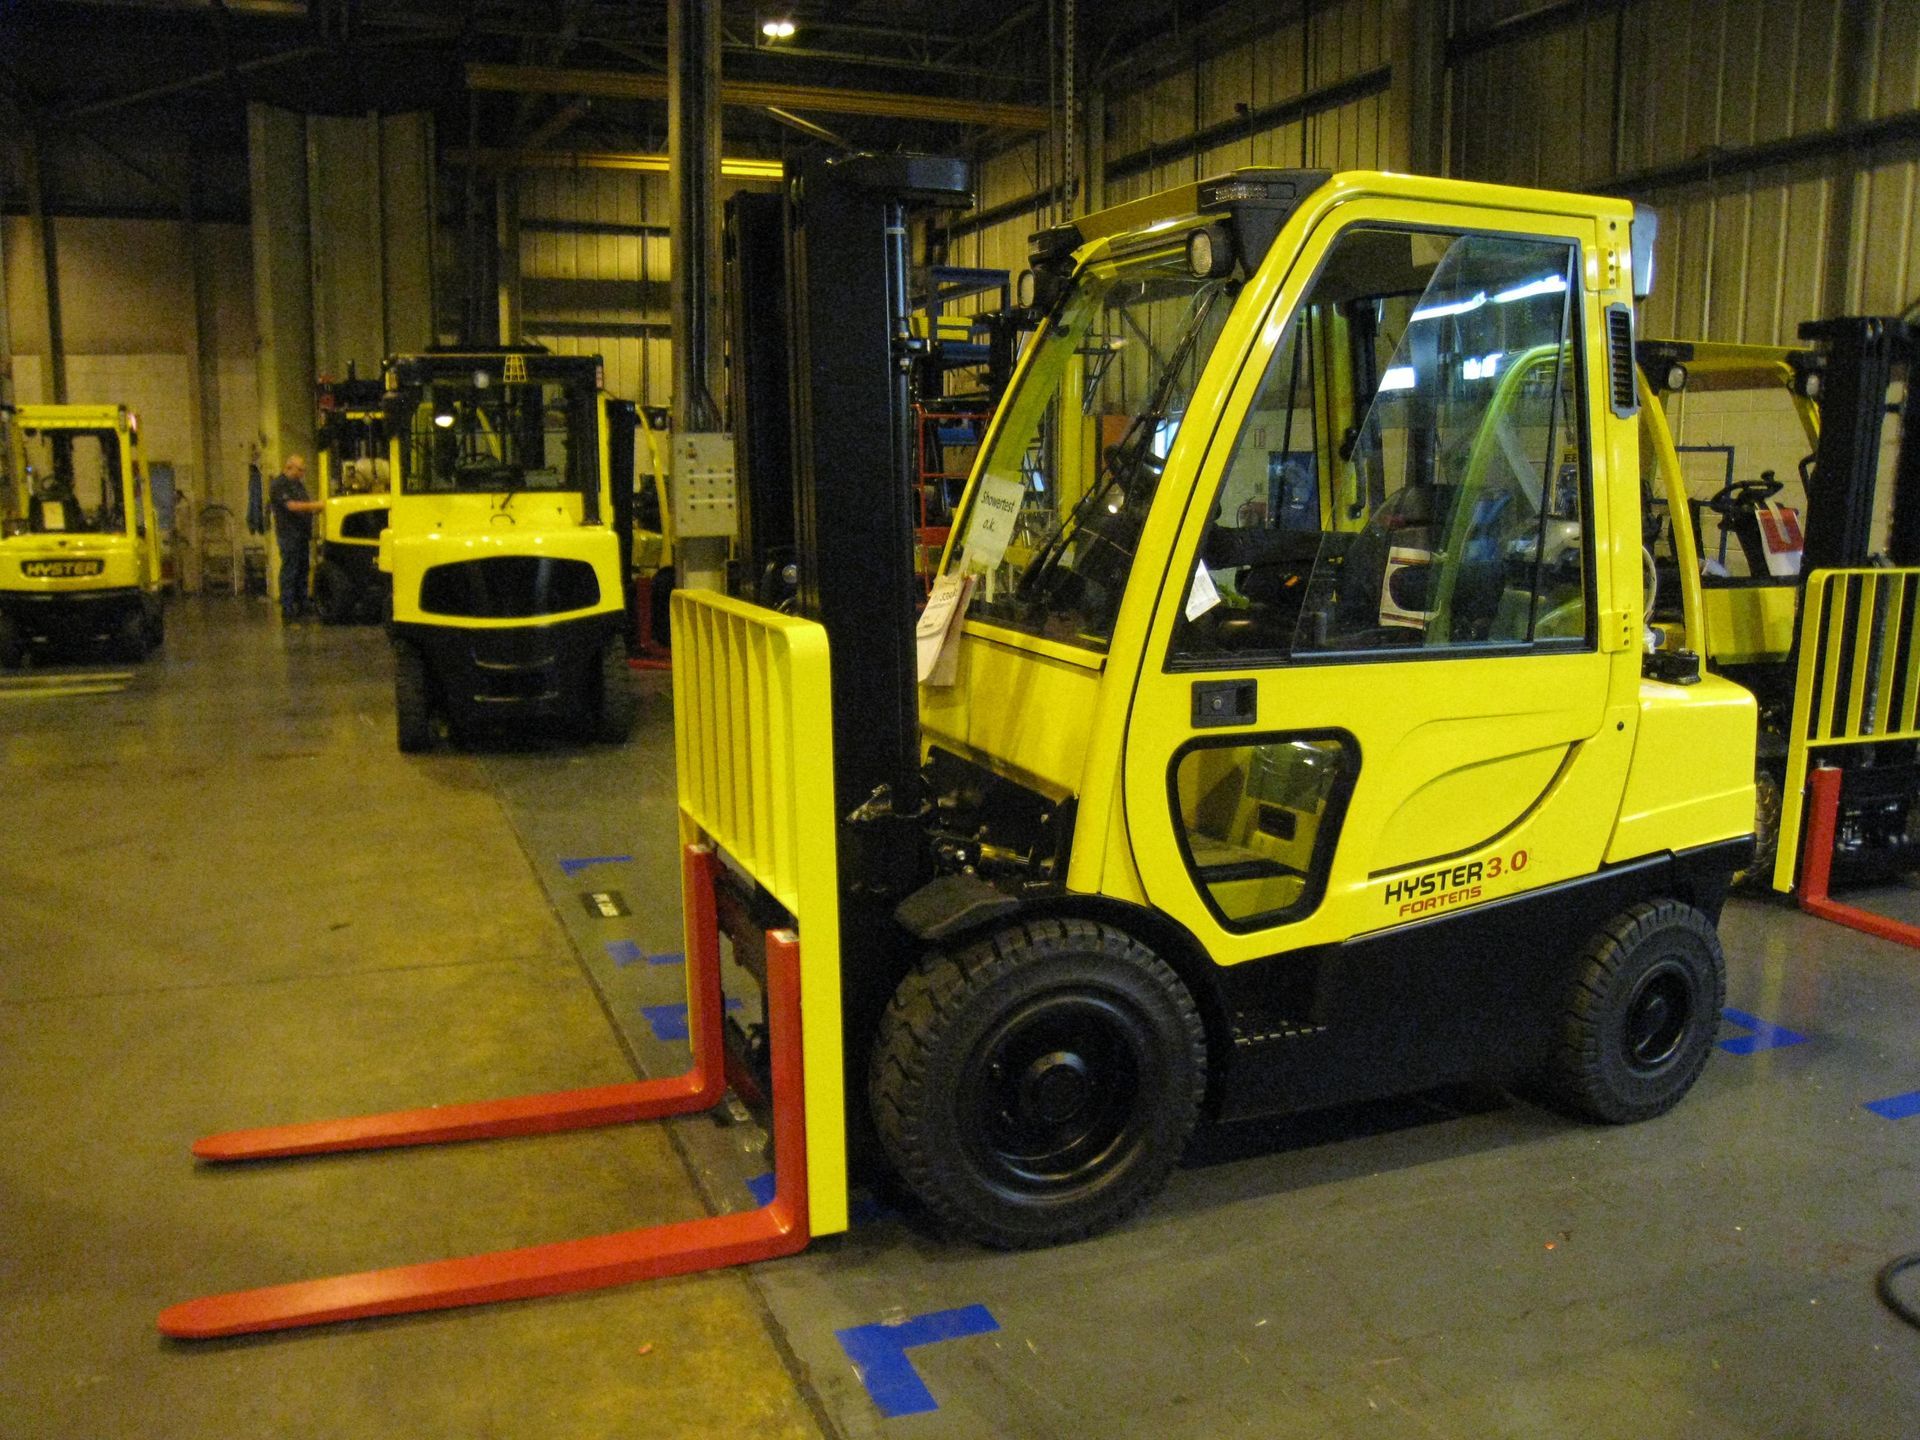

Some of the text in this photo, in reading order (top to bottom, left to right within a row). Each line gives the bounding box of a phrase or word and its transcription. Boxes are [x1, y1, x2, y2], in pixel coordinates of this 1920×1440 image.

[981, 490, 1015, 513] Showertest
[26, 561, 98, 577] HYSTER
[1384, 850, 1528, 905] HYSTER 3.0
[1399, 885, 1482, 917] FORTENS
